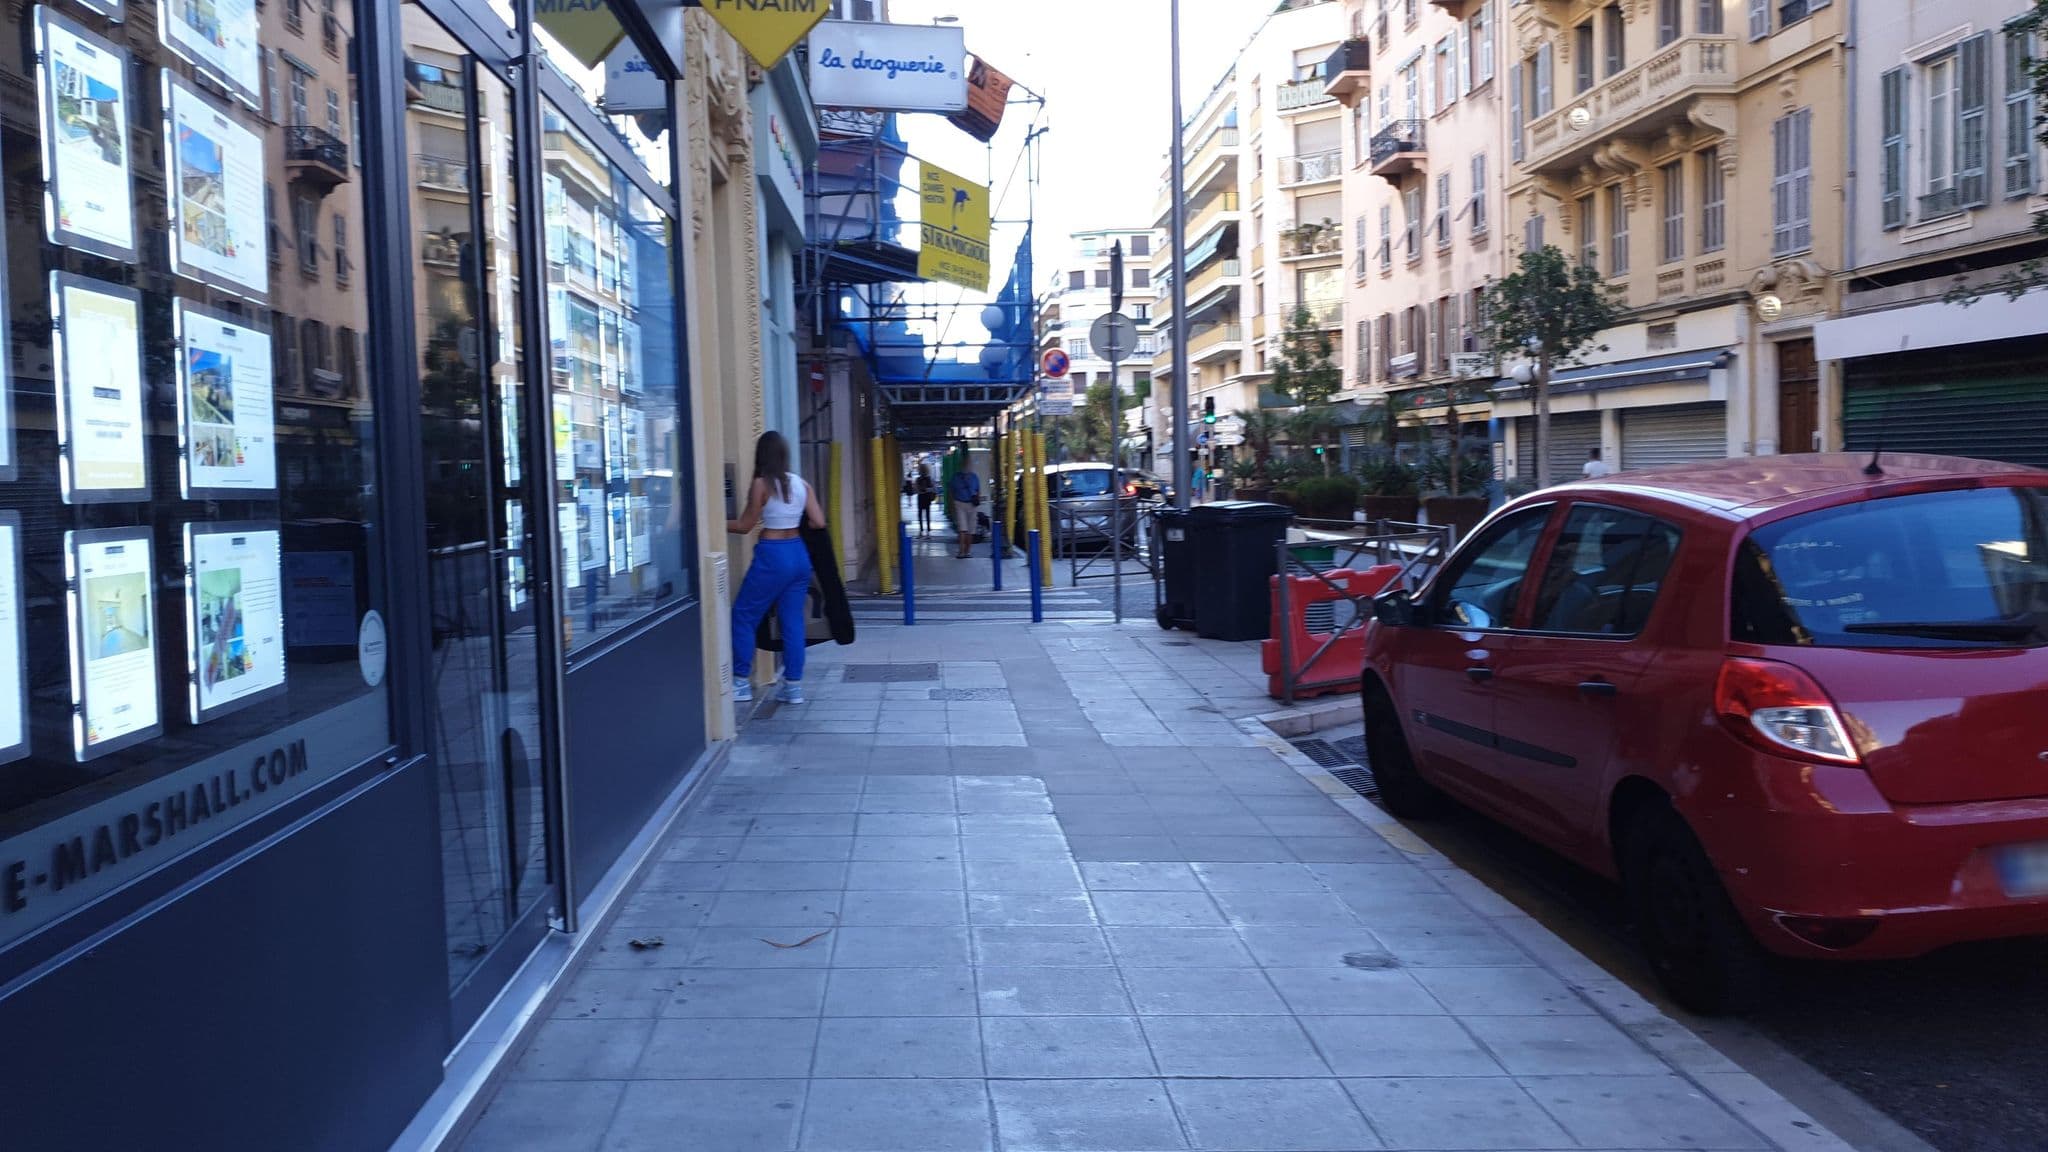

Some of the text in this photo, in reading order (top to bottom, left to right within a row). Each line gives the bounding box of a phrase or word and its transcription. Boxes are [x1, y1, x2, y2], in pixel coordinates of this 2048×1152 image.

[818, 48, 946, 80] la droguerie
[5, 738, 309, 913] E-MARSHALL.COM
